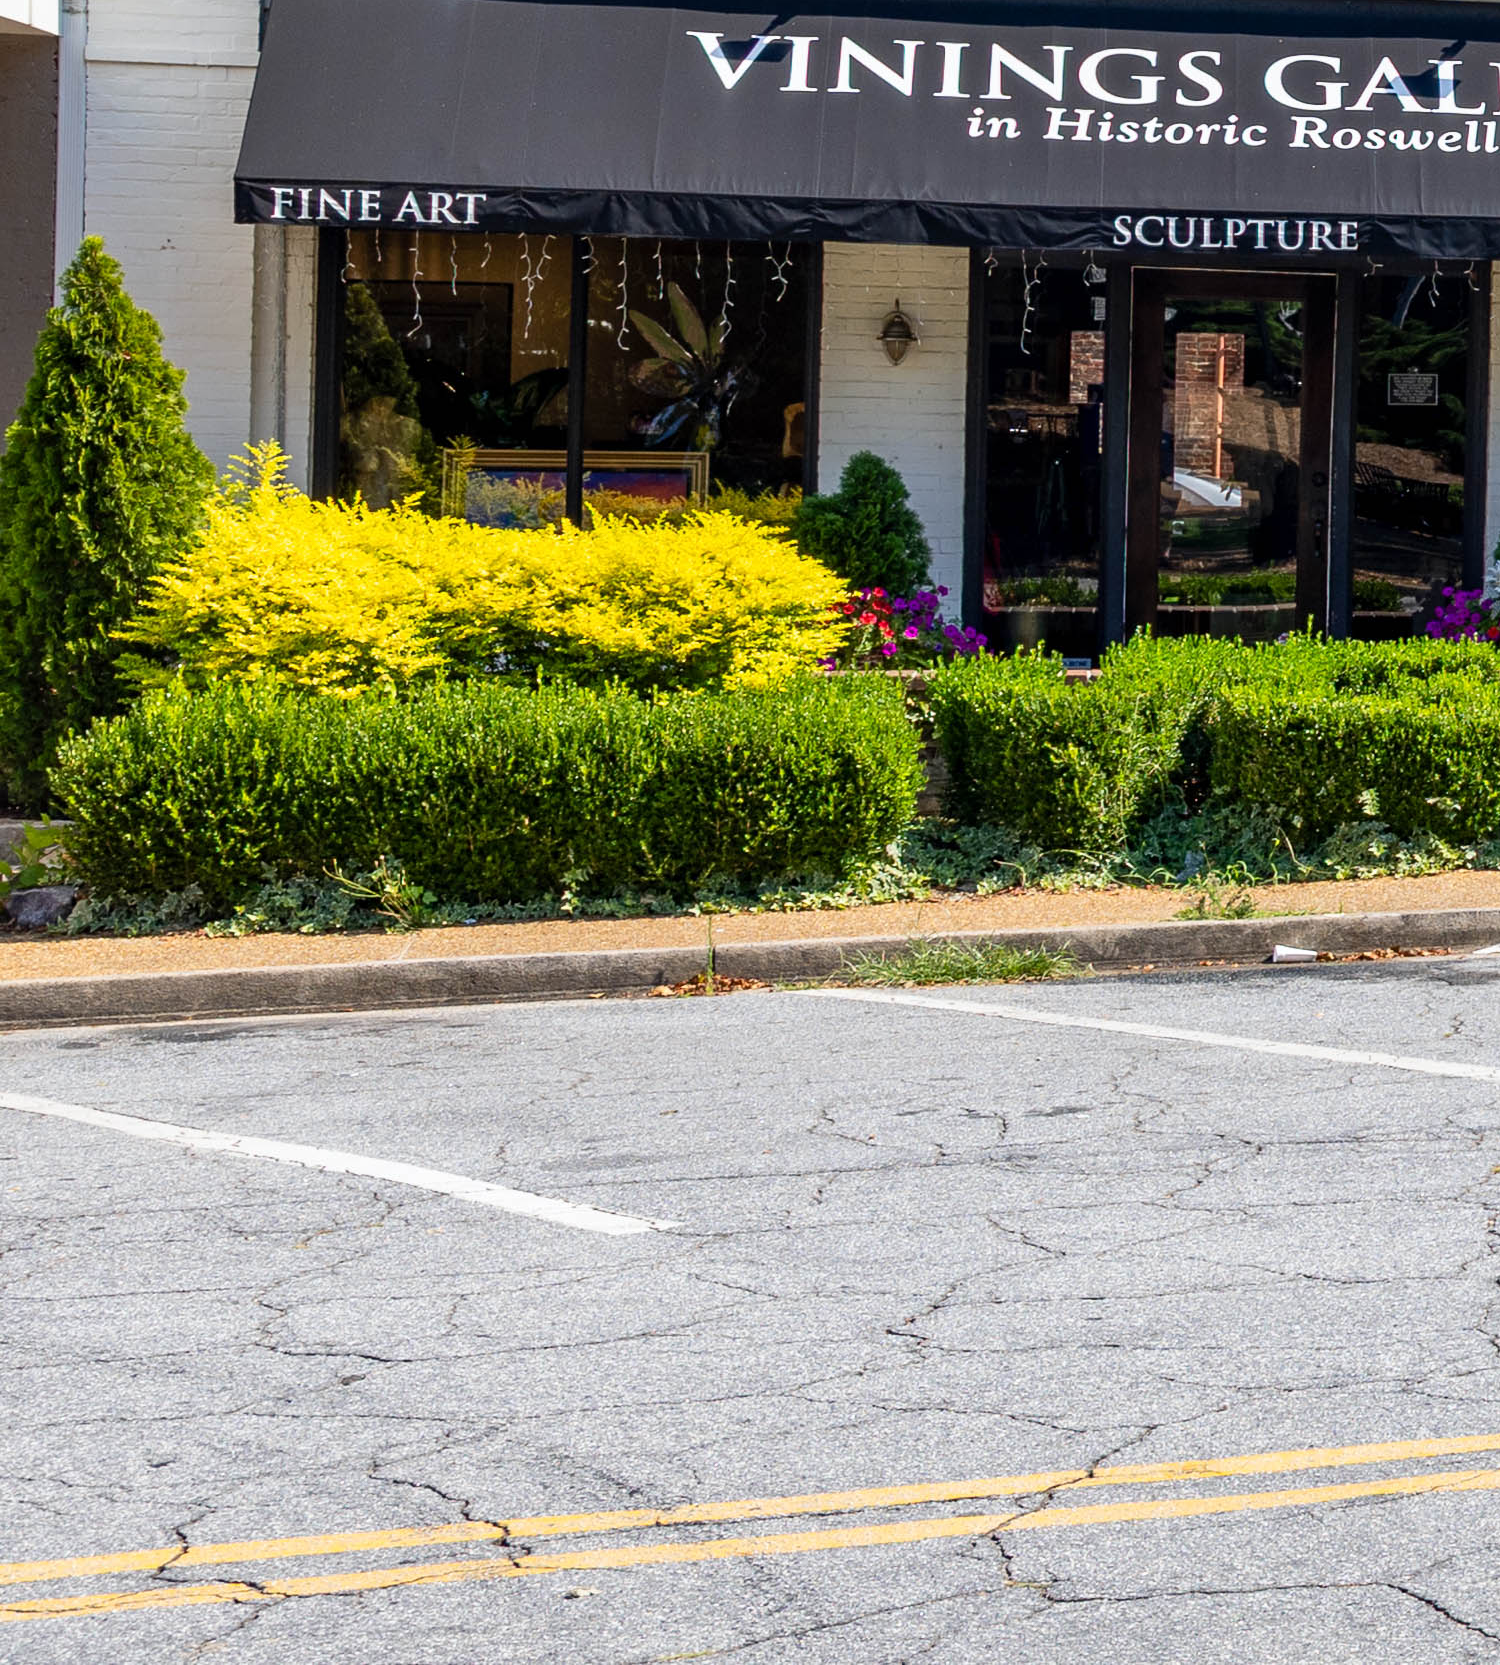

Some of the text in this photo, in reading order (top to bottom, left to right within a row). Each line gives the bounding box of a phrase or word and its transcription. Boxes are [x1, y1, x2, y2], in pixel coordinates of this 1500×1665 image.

[686, 30, 1224, 107] VININGS
[967, 106, 1500, 155] in Historic Roswell
[270, 187, 488, 225] FINE ART
[1113, 215, 1359, 252] SCULPTURE
